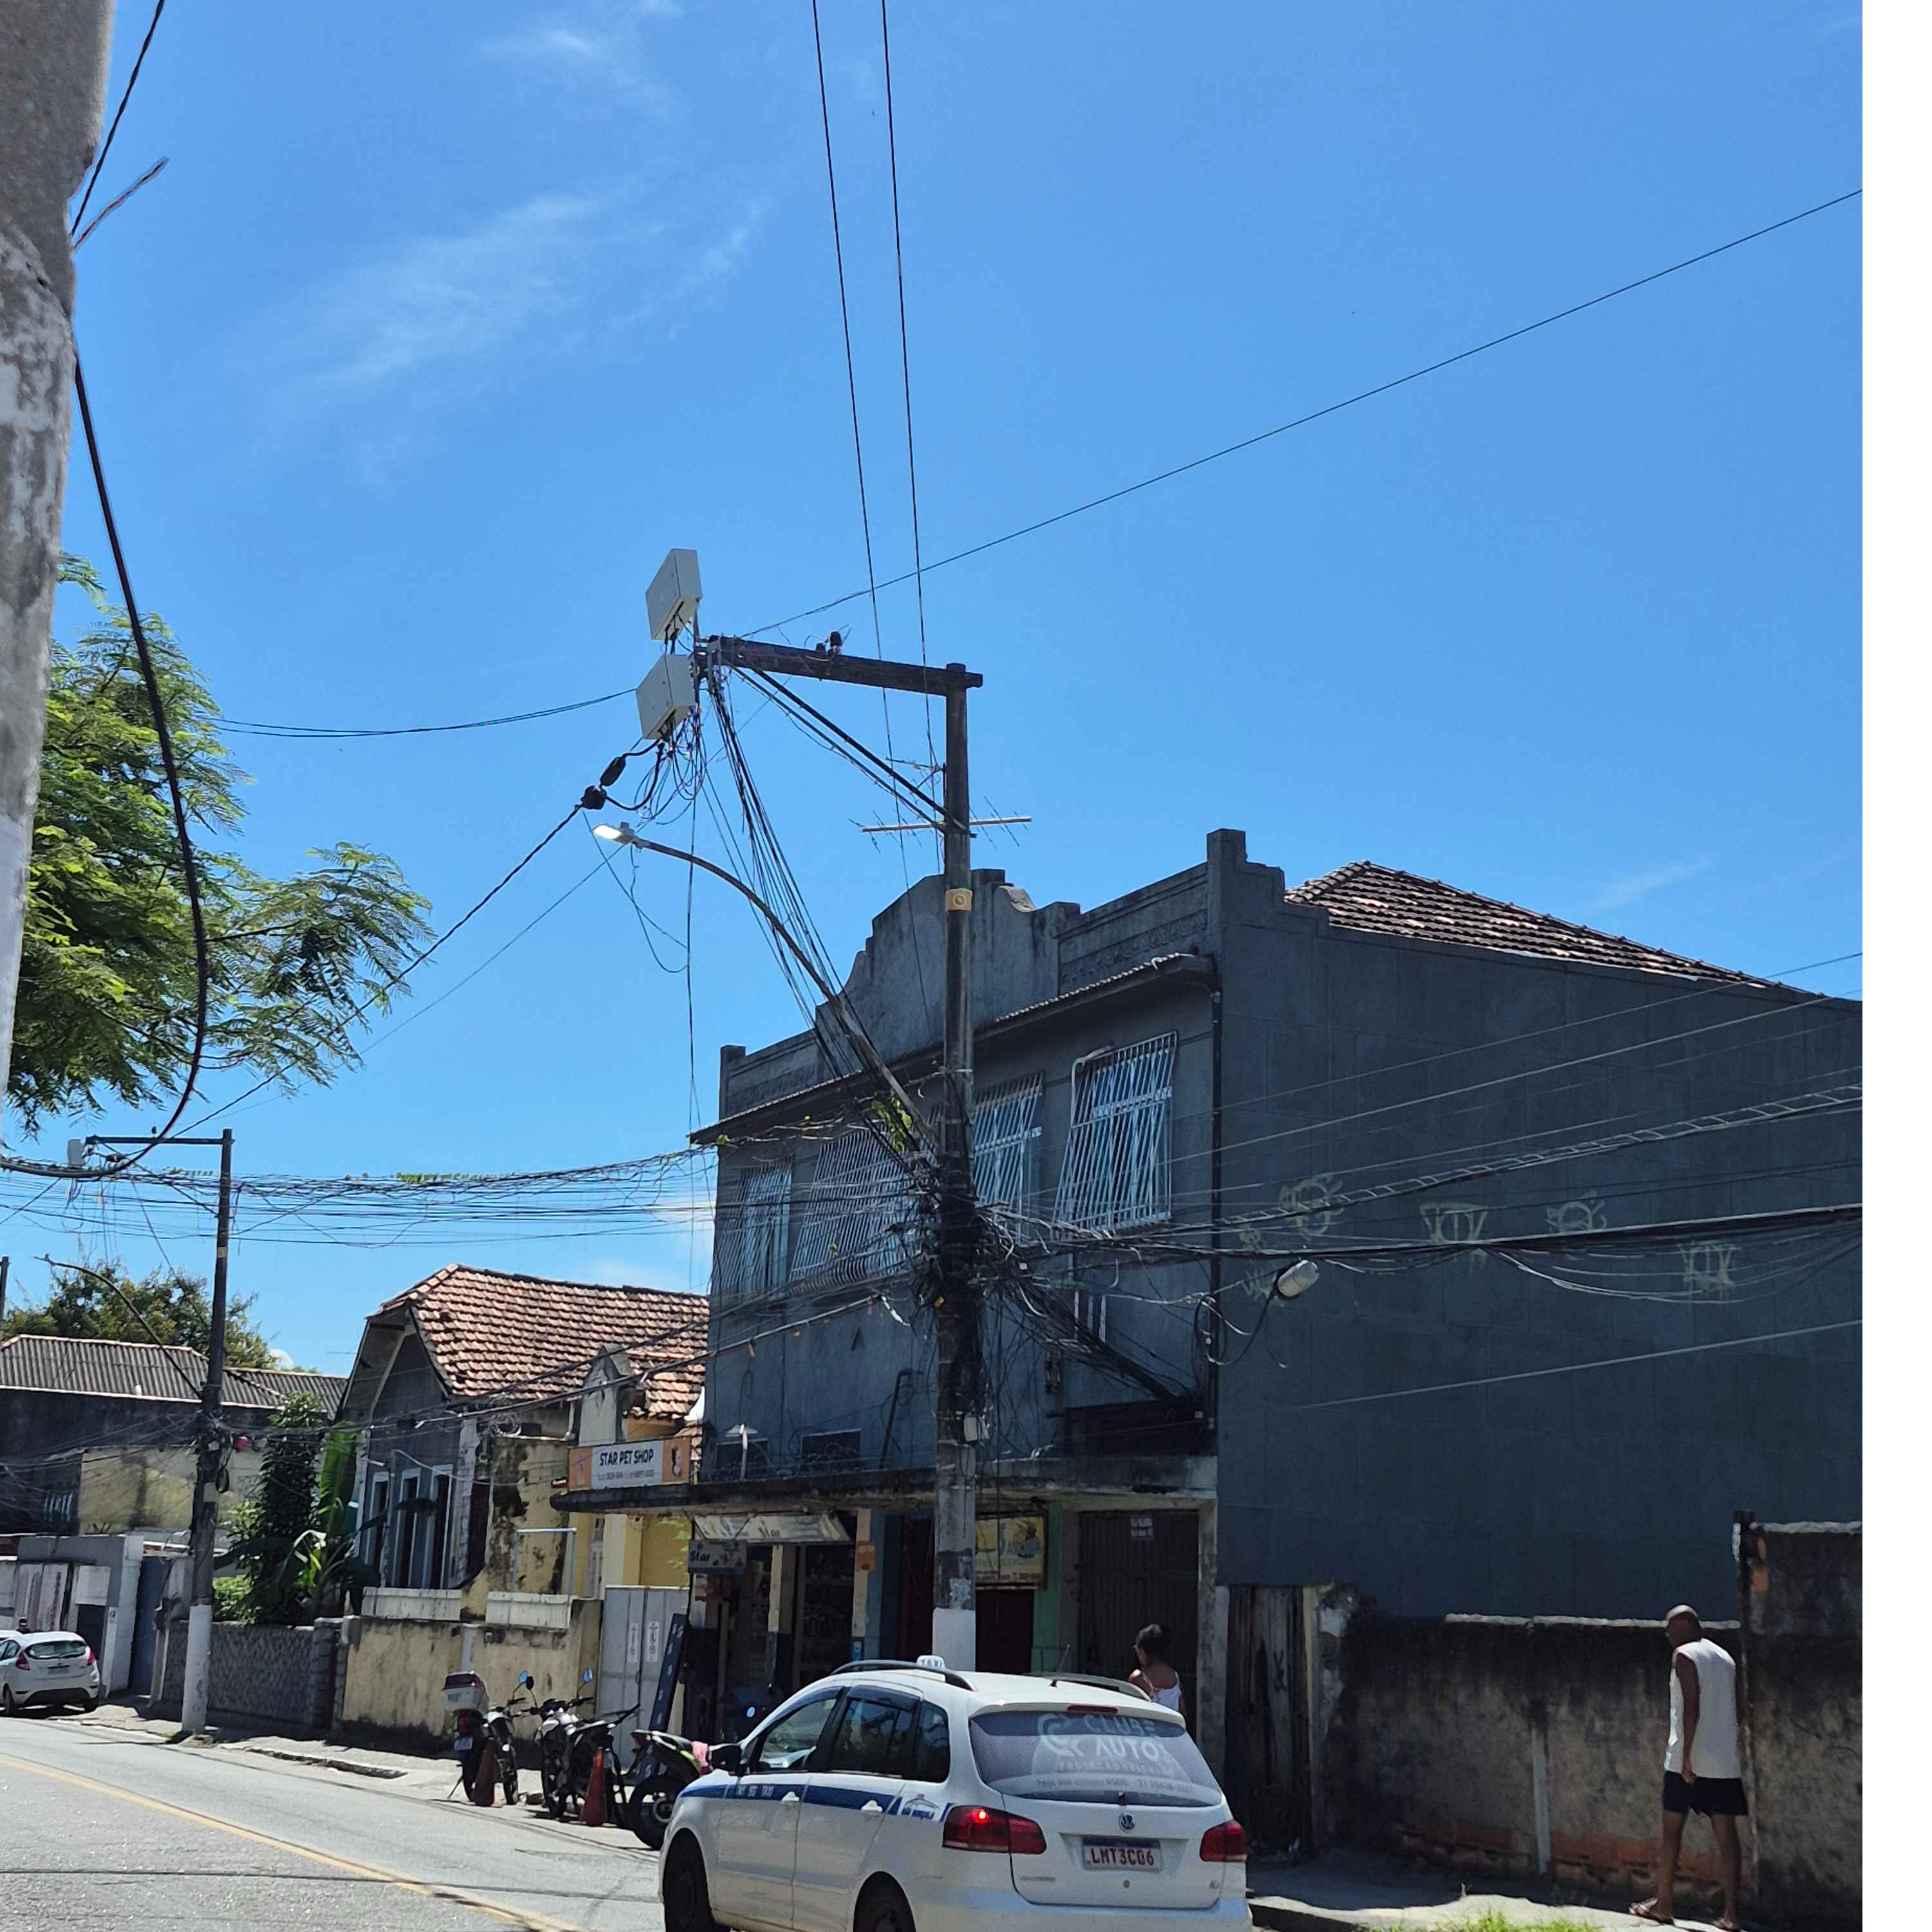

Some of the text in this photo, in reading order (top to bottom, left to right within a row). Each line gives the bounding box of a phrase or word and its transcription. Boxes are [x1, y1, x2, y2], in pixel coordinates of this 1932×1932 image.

[600, 1448, 654, 1466] STAR PET SHOP
[689, 1549, 710, 1562] Star
[1083, 1714, 1157, 1737] CLUBE
